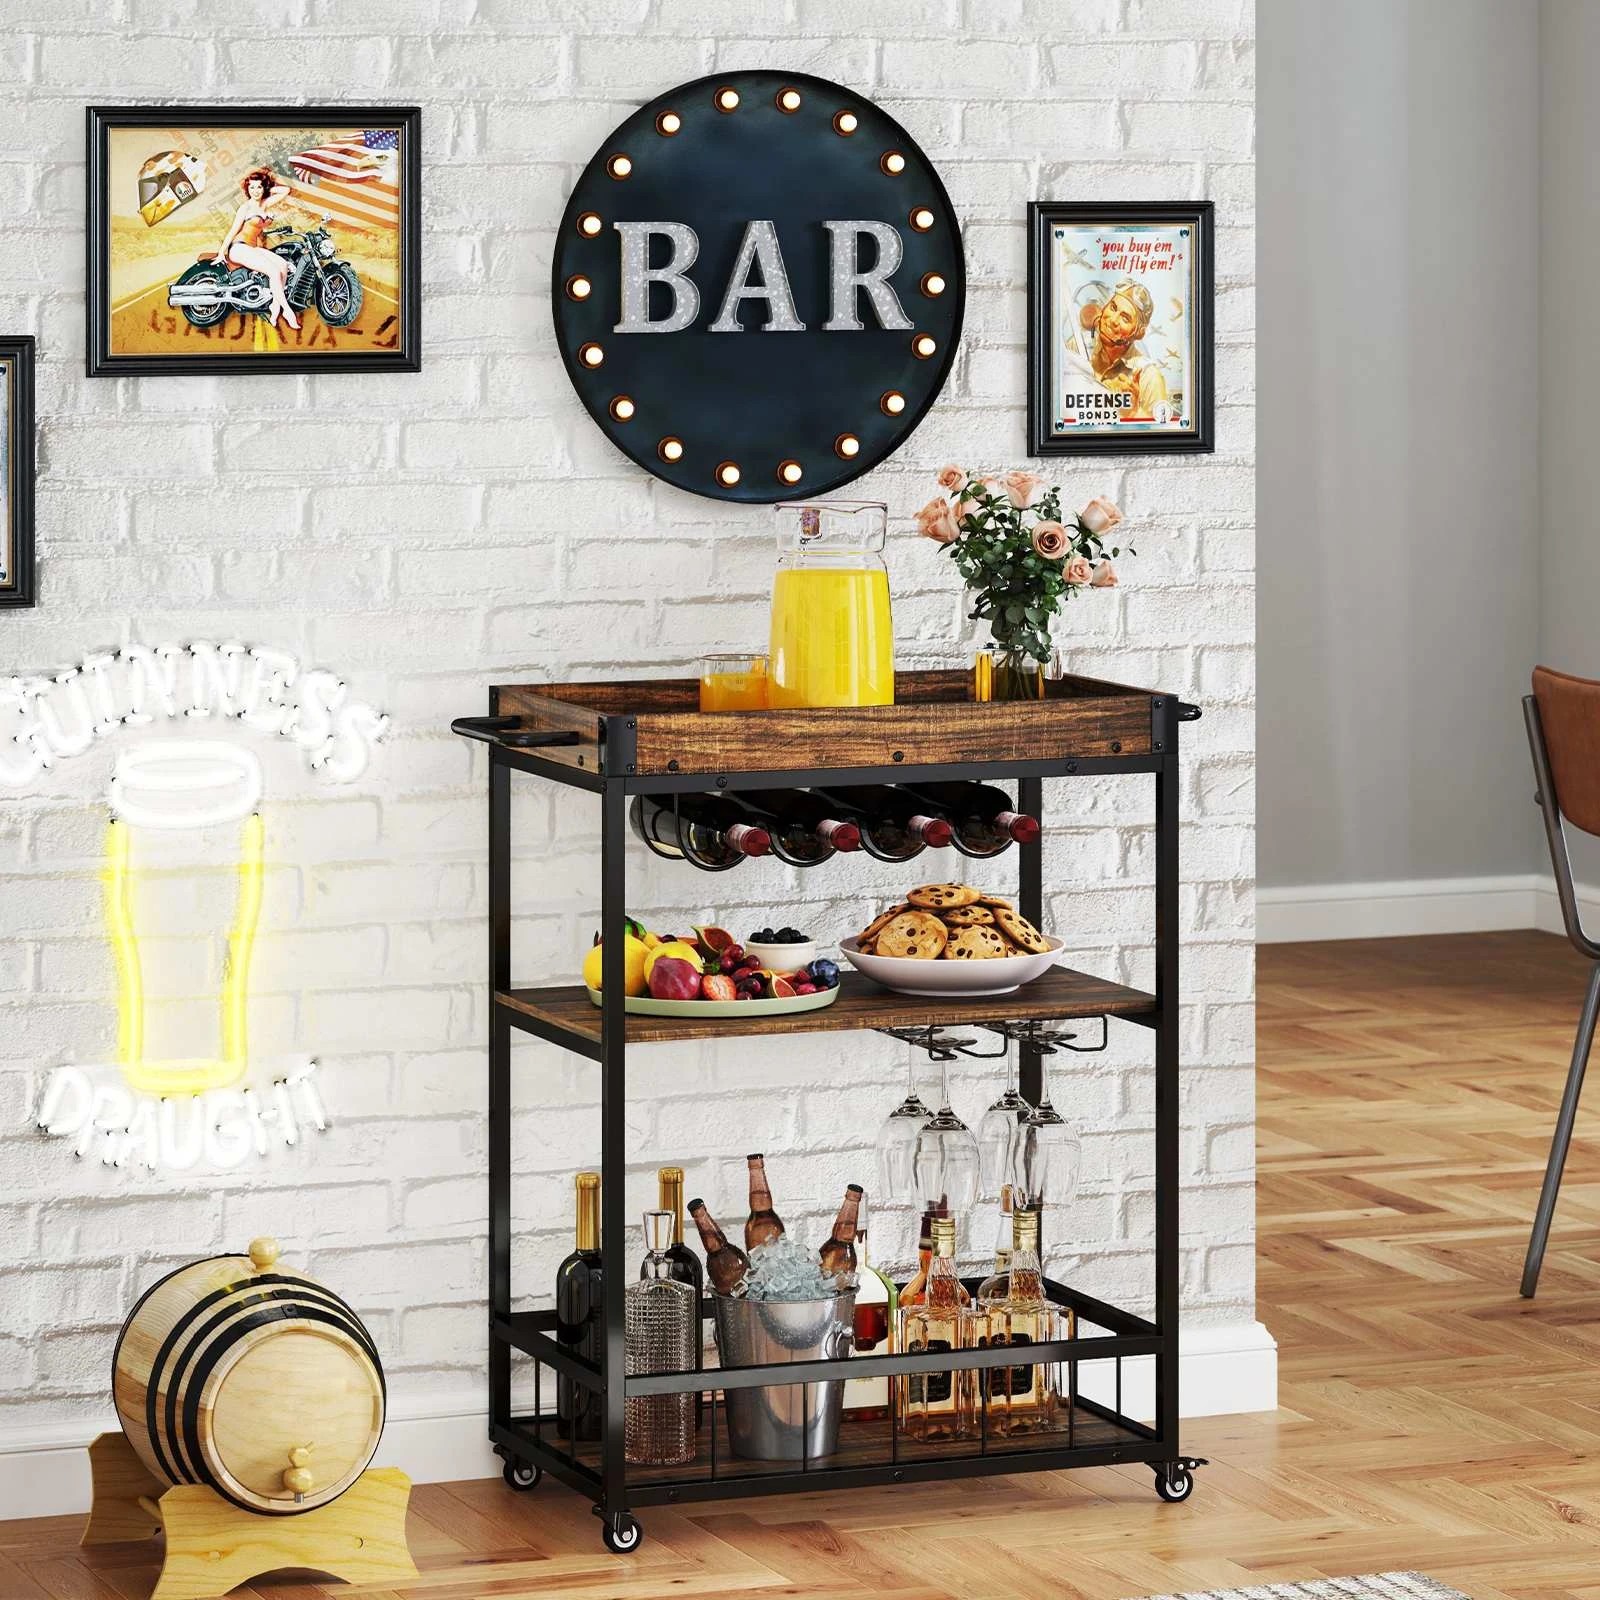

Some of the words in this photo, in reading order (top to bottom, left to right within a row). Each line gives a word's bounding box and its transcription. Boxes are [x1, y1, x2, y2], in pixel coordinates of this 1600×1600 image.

[1128, 236, 1151, 257] buy
[1126, 253, 1148, 274] fly
[613, 220, 914, 333] BAR
[1065, 393, 1131, 409] DEFENSE
[1078, 411, 1118, 420] BONDS
[37, 1060, 328, 1169] DRAUGHT
